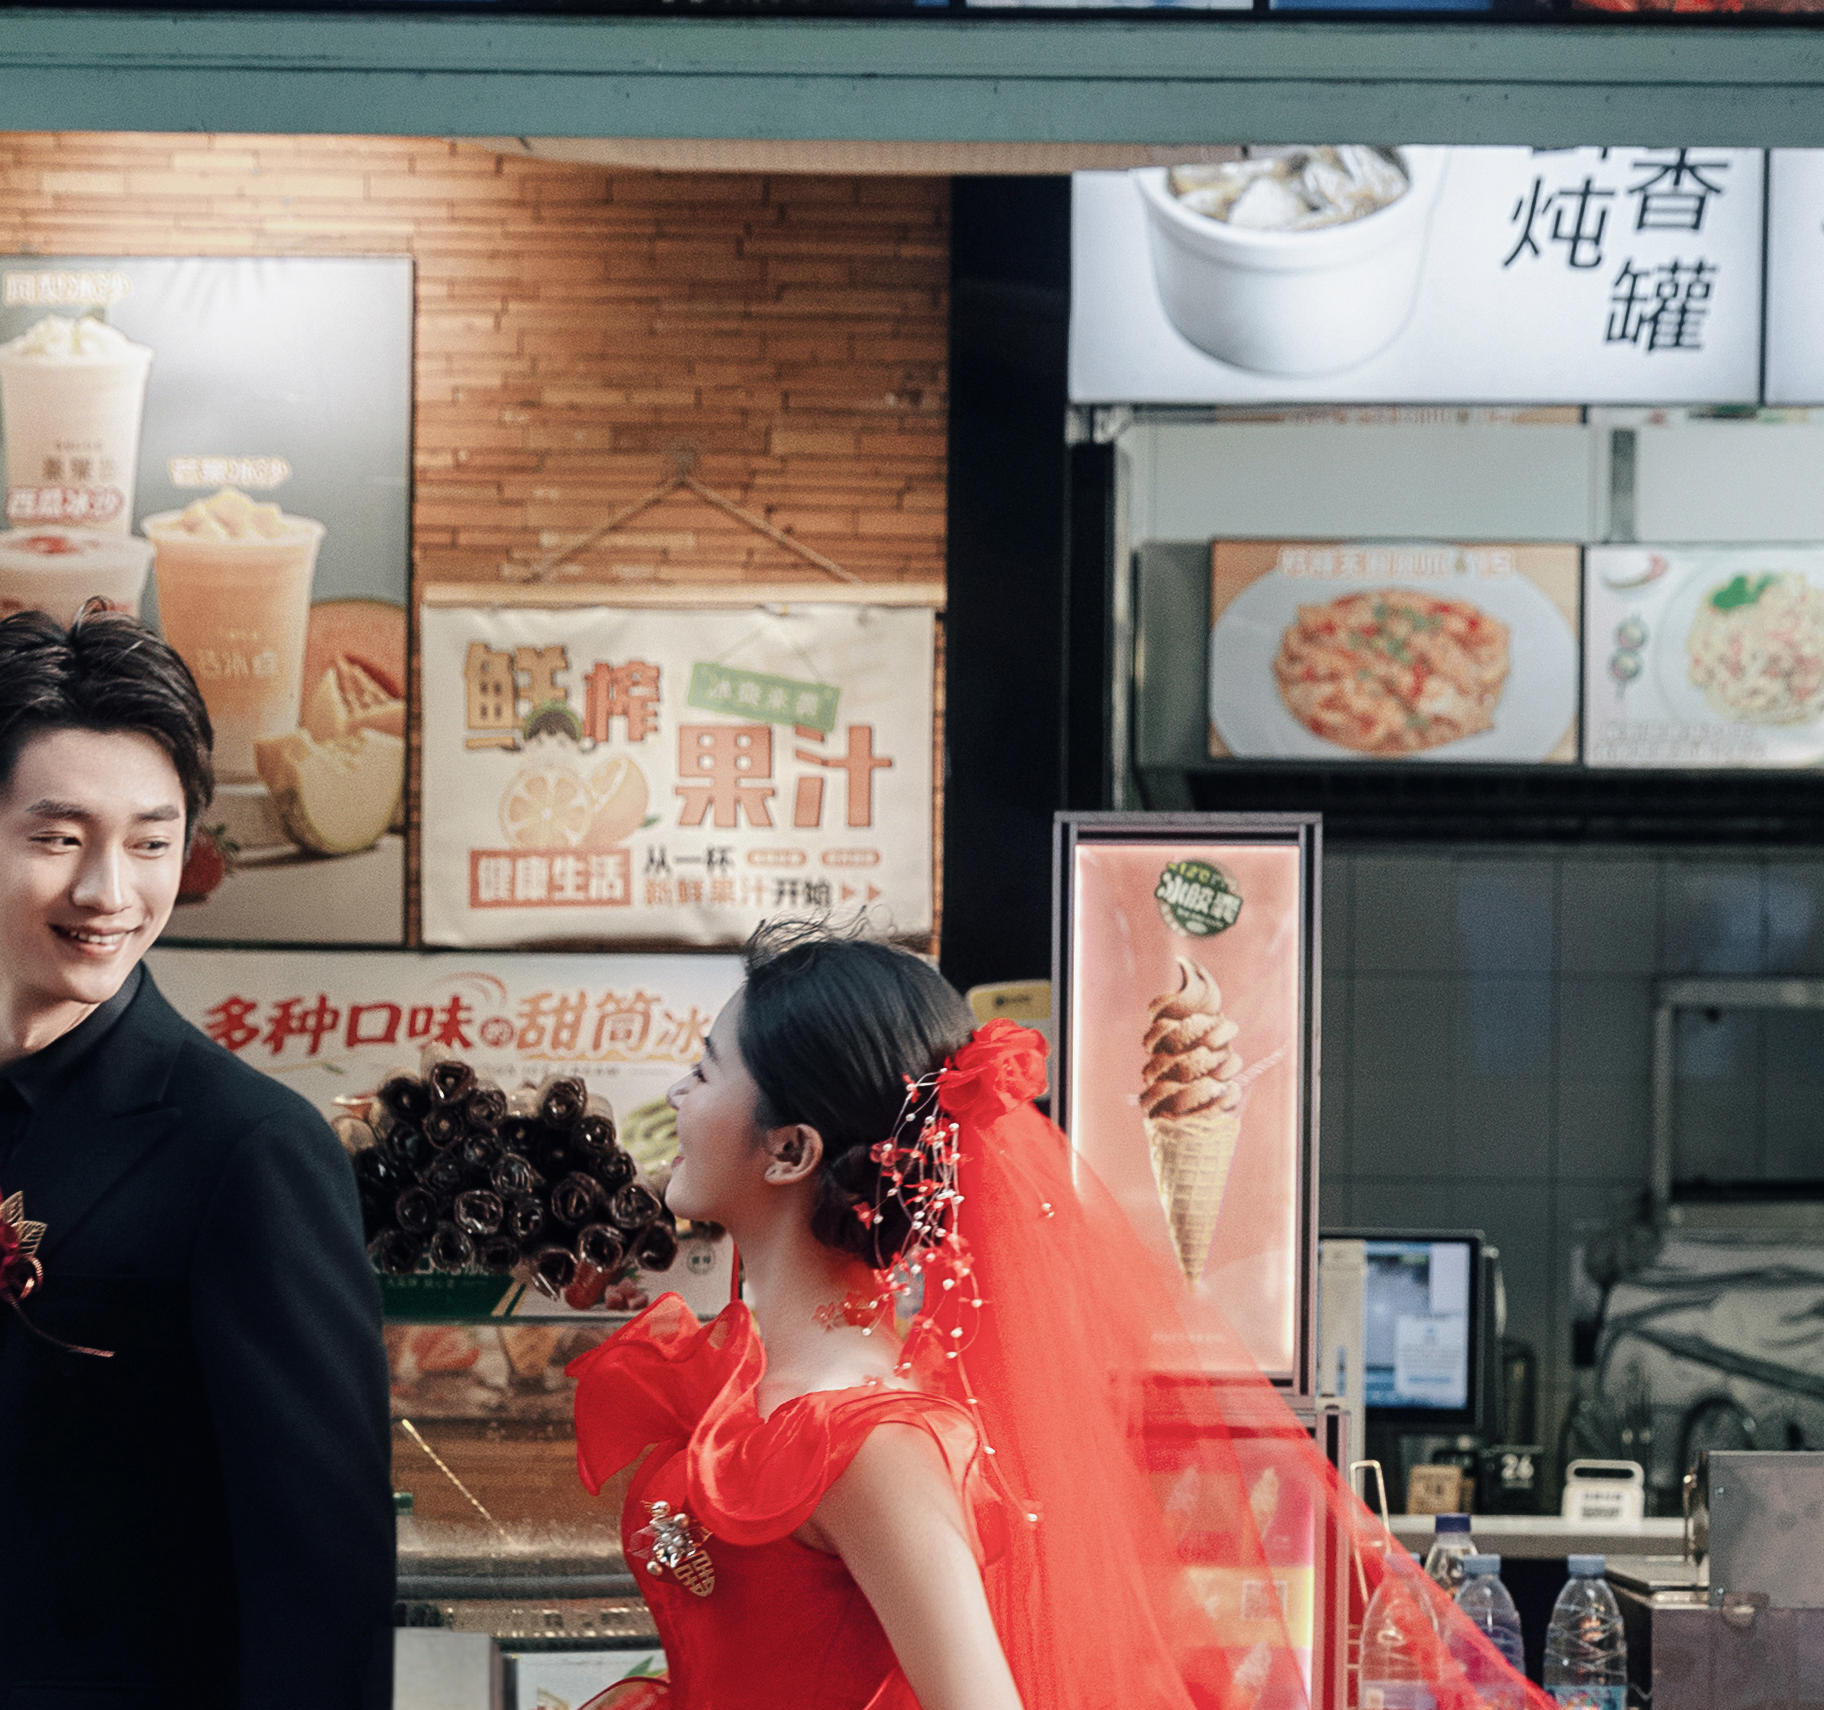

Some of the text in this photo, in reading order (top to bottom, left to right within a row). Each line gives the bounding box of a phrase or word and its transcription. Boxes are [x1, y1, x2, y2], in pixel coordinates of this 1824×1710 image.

[674, 724, 893, 828] 果汁
[477, 854, 626, 902] 健康生活
[645, 847, 734, 874] 从一杯
[1501, 1453, 1535, 1480] 26
